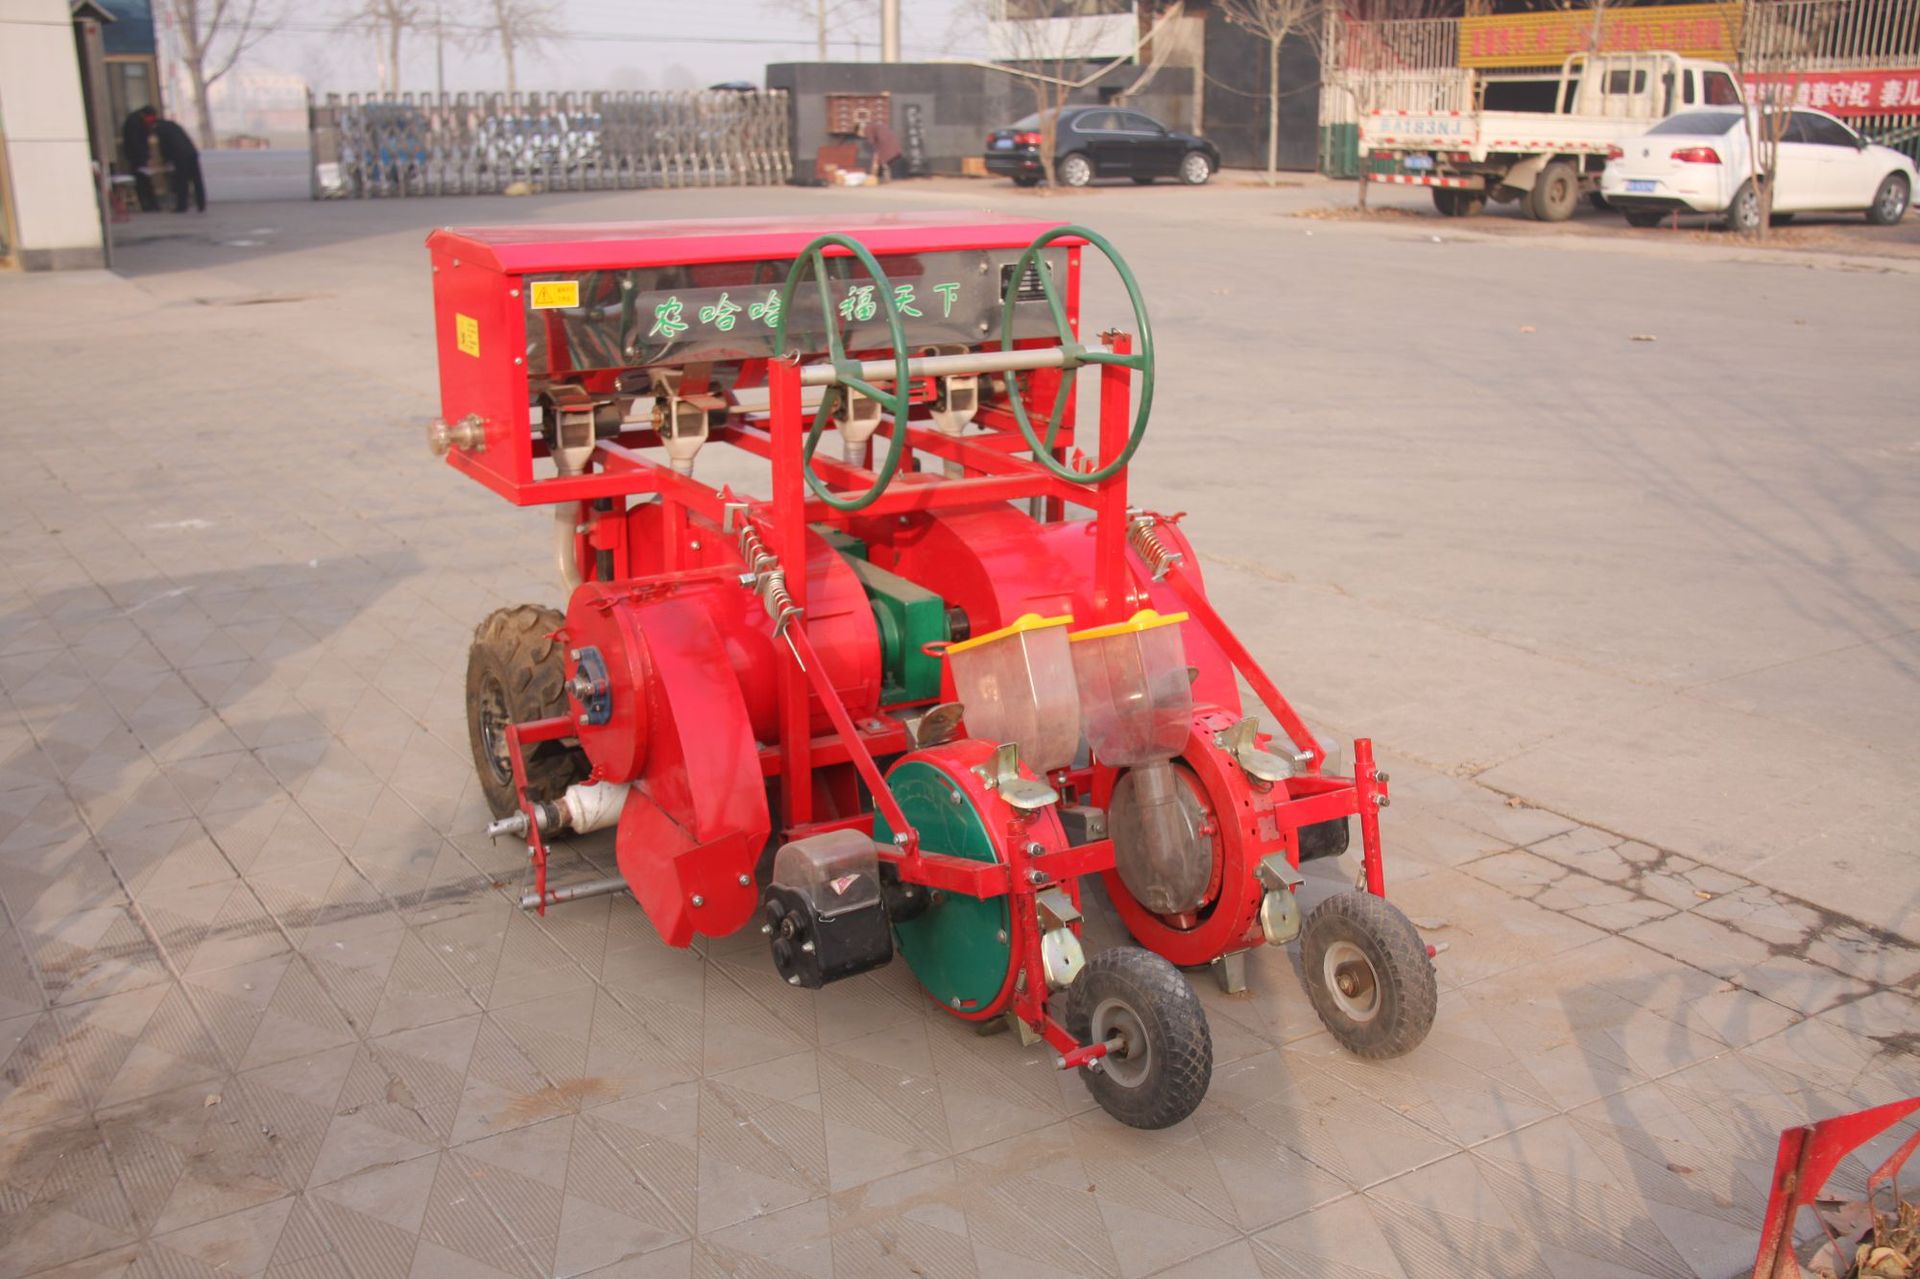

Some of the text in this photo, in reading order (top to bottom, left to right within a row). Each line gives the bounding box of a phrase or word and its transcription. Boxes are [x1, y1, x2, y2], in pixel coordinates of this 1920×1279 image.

[649, 289, 783, 337] 农哈哈
[839, 282, 961, 321] 福天下
